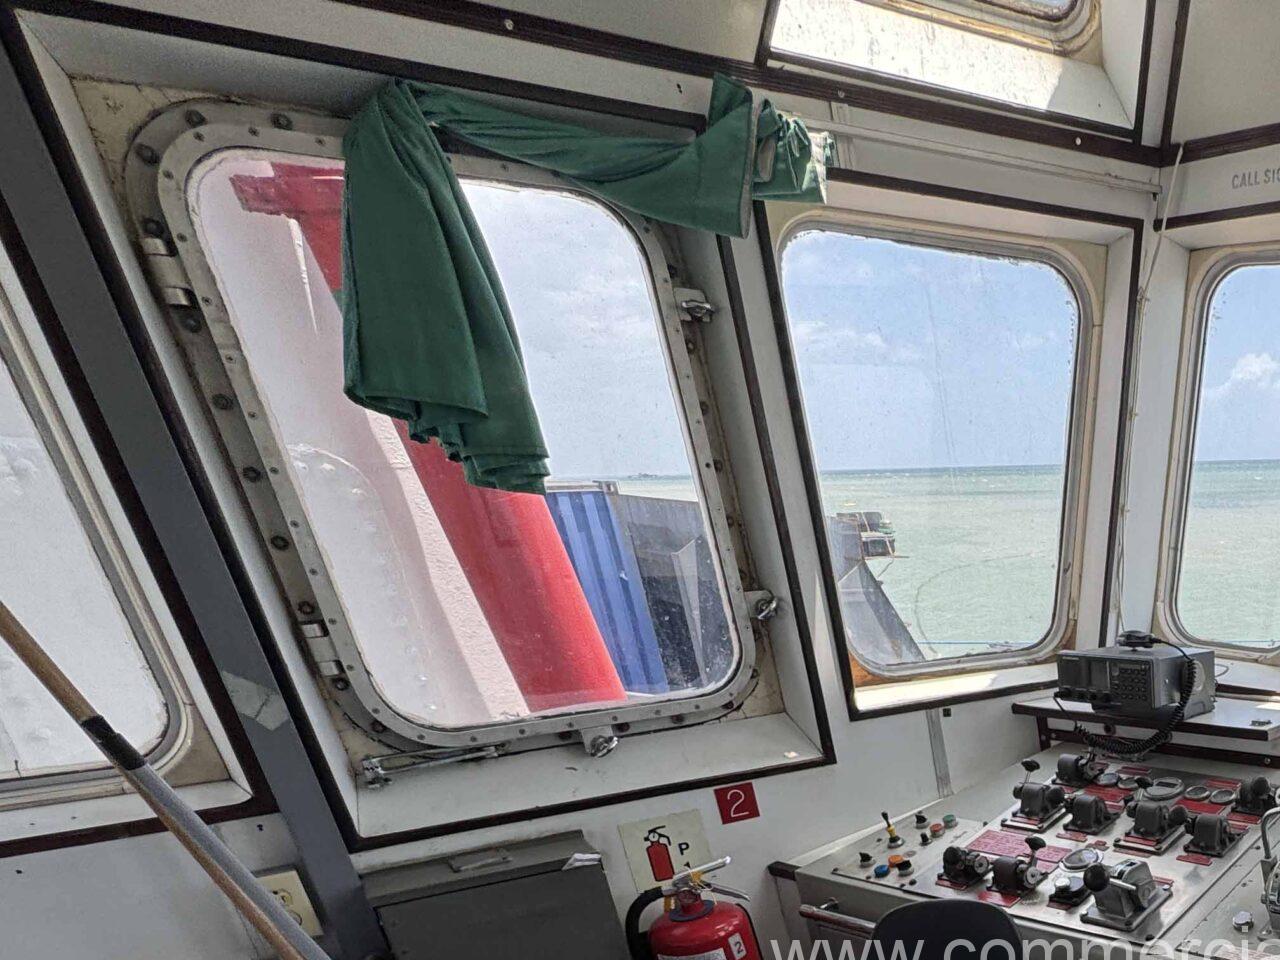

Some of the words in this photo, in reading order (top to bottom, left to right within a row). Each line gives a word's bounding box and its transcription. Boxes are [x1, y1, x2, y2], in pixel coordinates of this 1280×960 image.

[1231, 170, 1260, 189] CALL
[727, 789, 750, 817] 2
[678, 842, 690, 856] P
[734, 941, 744, 954] 2
